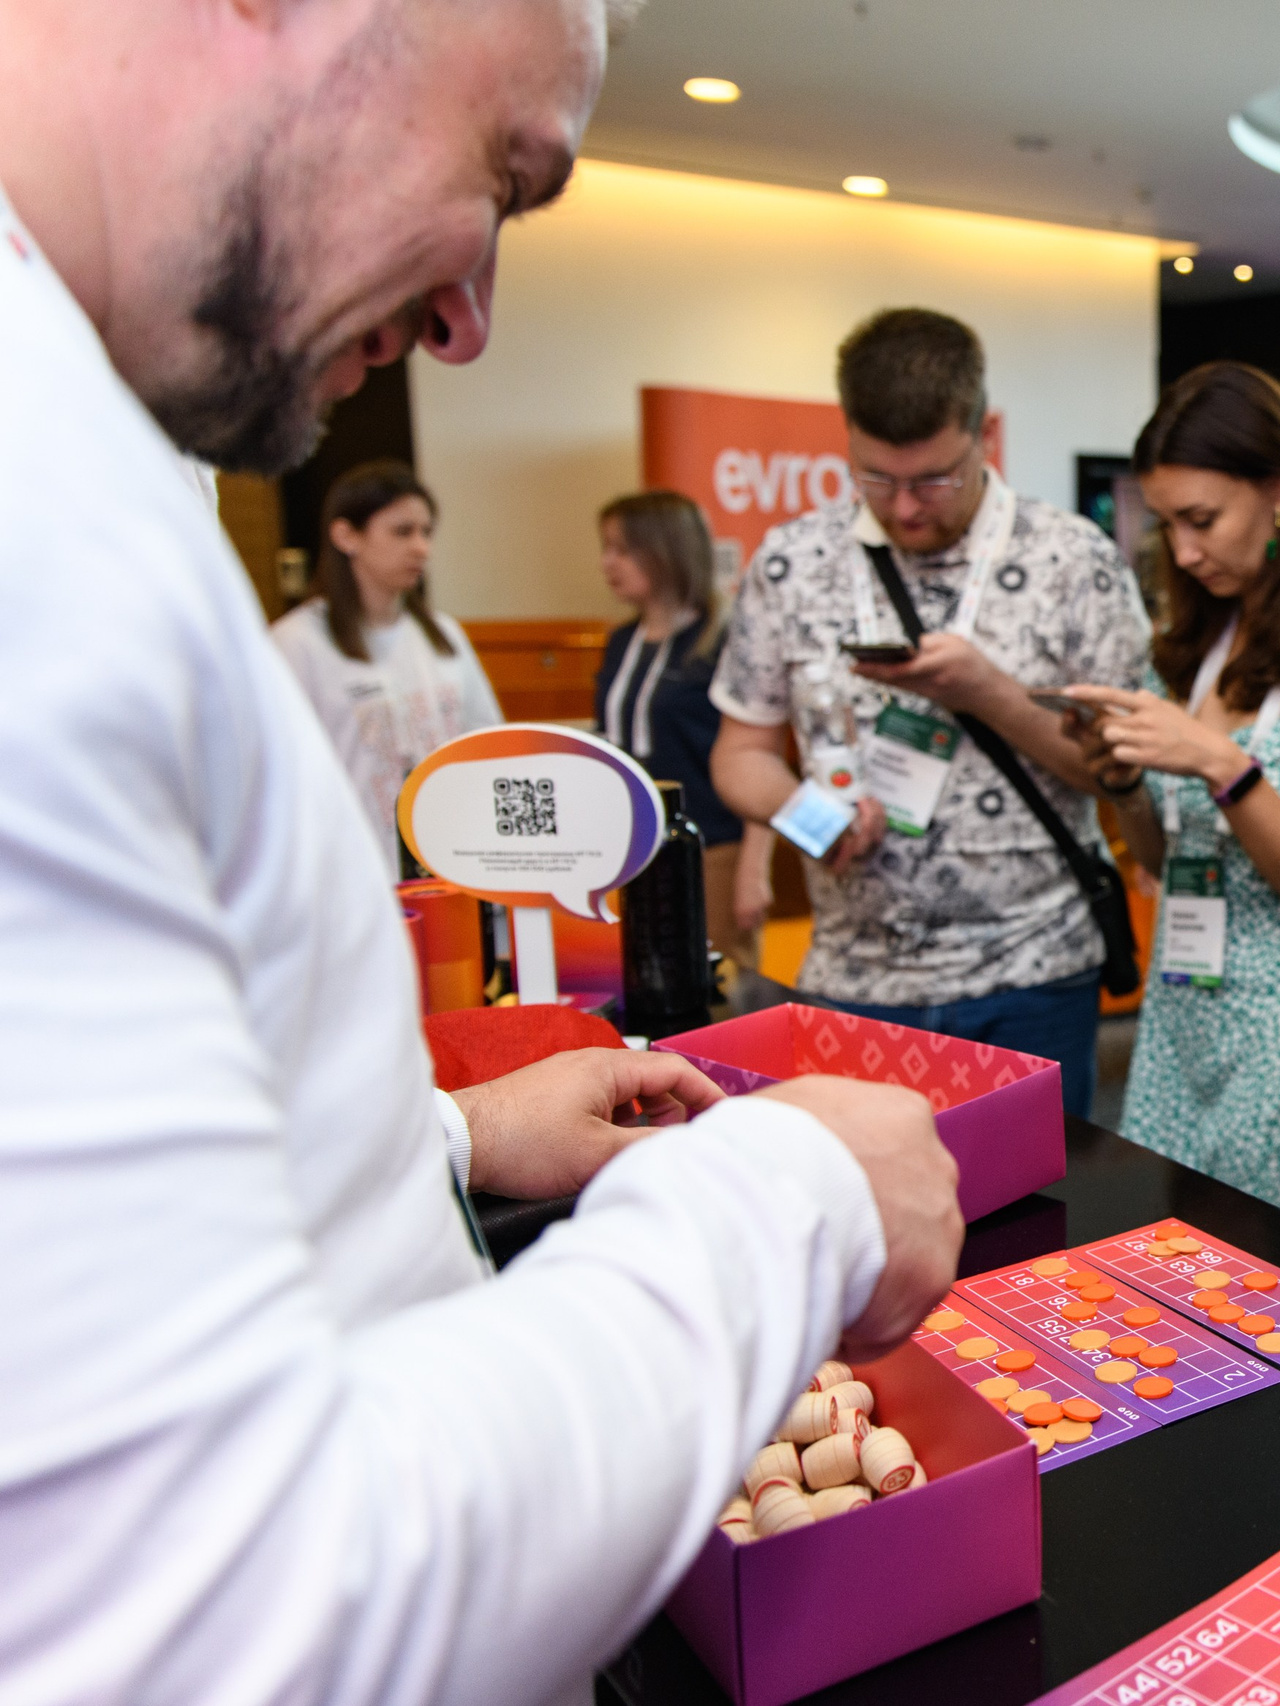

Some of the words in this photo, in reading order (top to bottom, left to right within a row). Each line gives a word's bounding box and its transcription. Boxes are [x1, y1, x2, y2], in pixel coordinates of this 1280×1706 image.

[1169, 1260, 1196, 1273] 63
[1009, 1273, 1035, 1286] 81
[1037, 1319, 1067, 1335] 55
[1223, 1370, 1245, 1381] 2
[1117, 1672, 1160, 1705] 44
[1155, 1645, 1202, 1676] 52
[1196, 1618, 1239, 1648] 64
